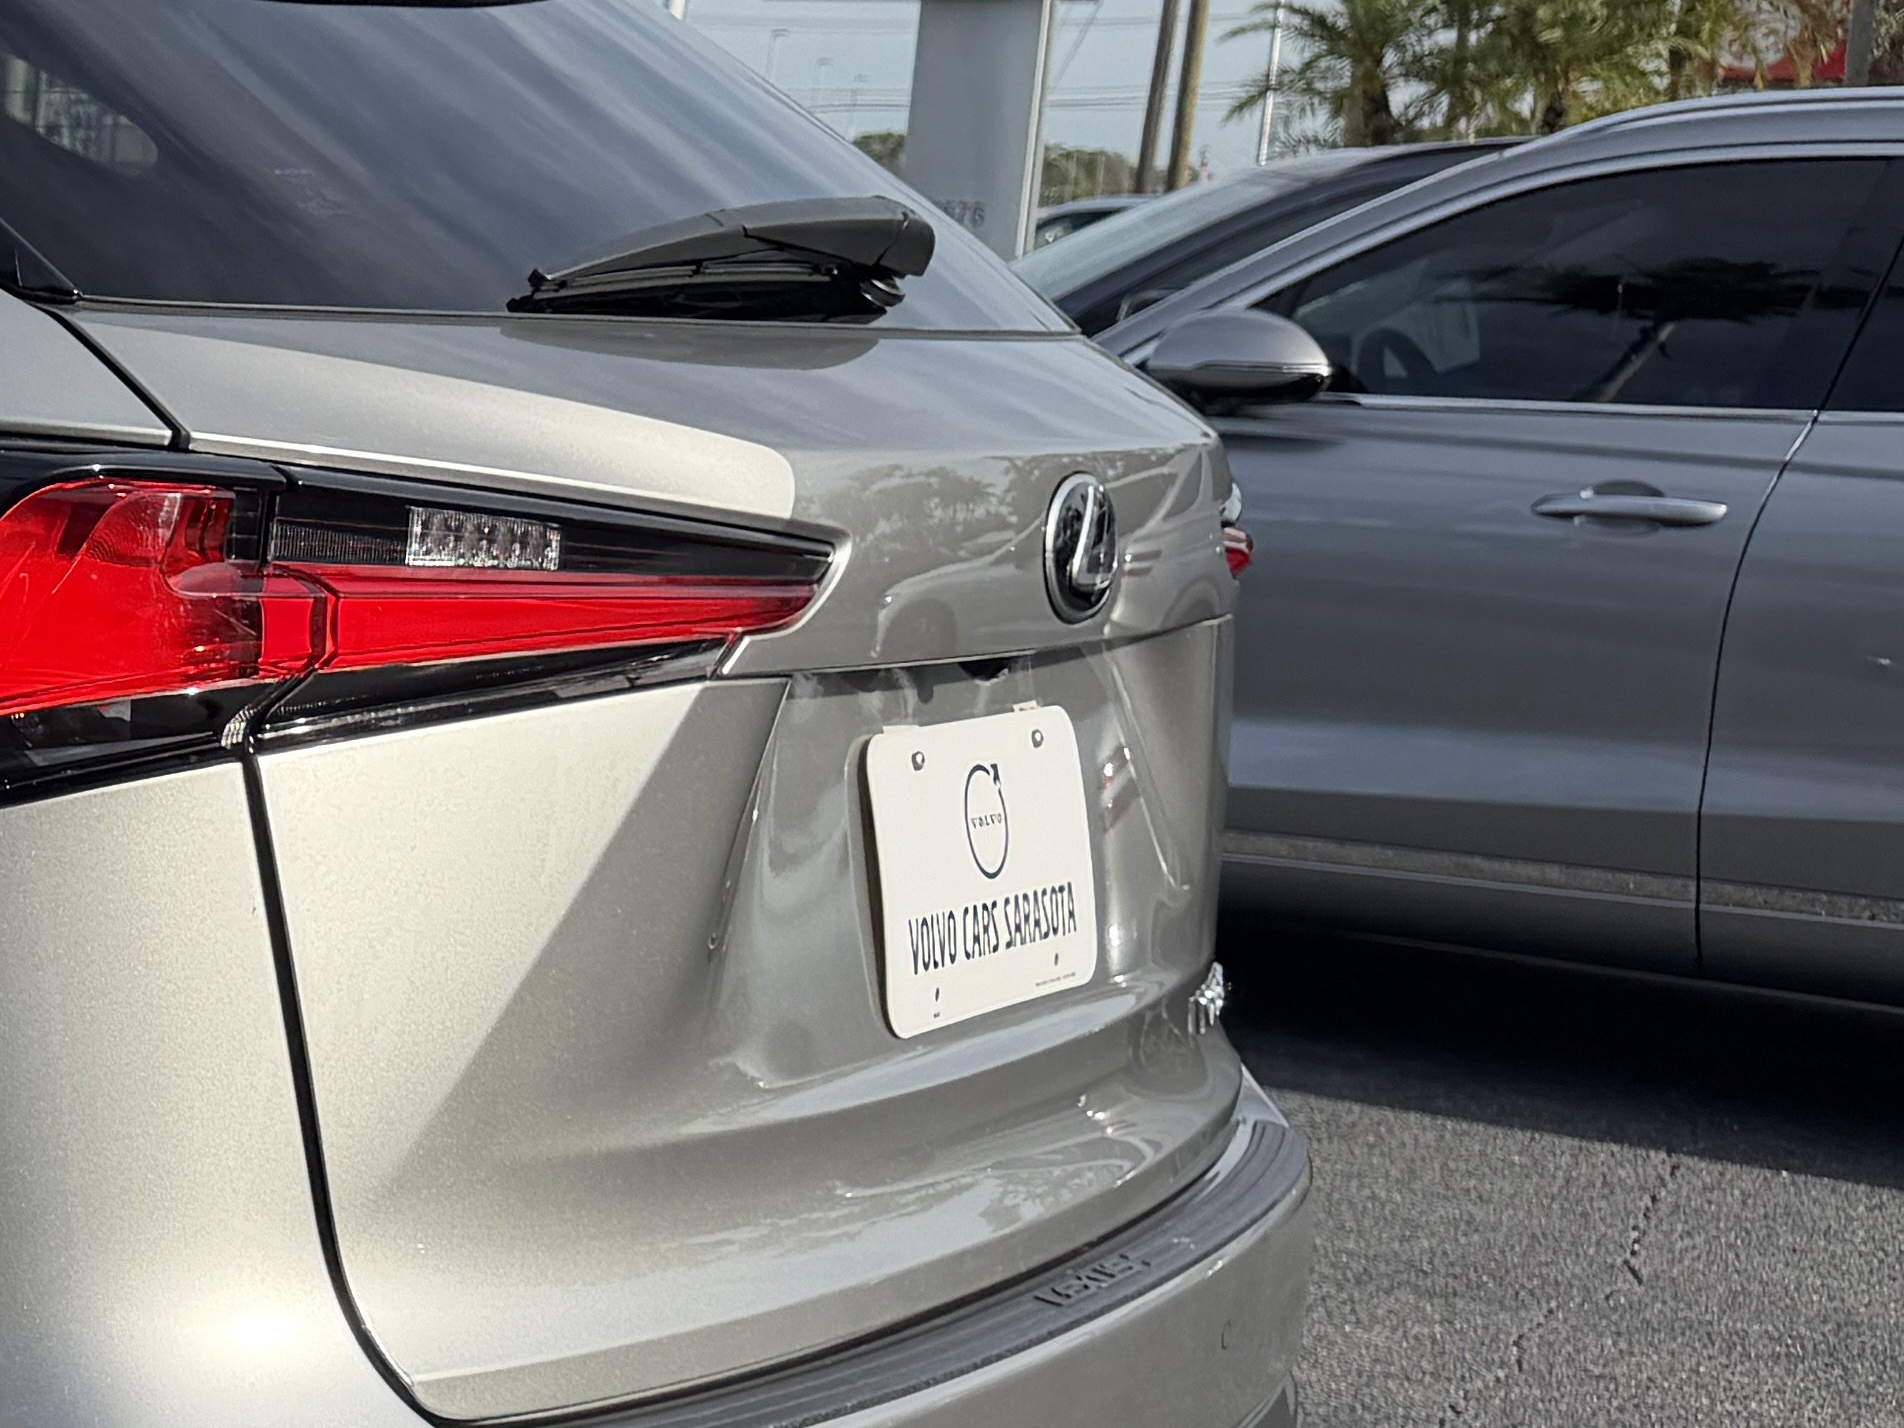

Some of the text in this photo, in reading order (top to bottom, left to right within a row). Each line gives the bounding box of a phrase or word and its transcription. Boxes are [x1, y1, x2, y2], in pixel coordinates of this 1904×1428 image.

[908, 881, 1077, 975] VOLVO CARS SARASOTA
